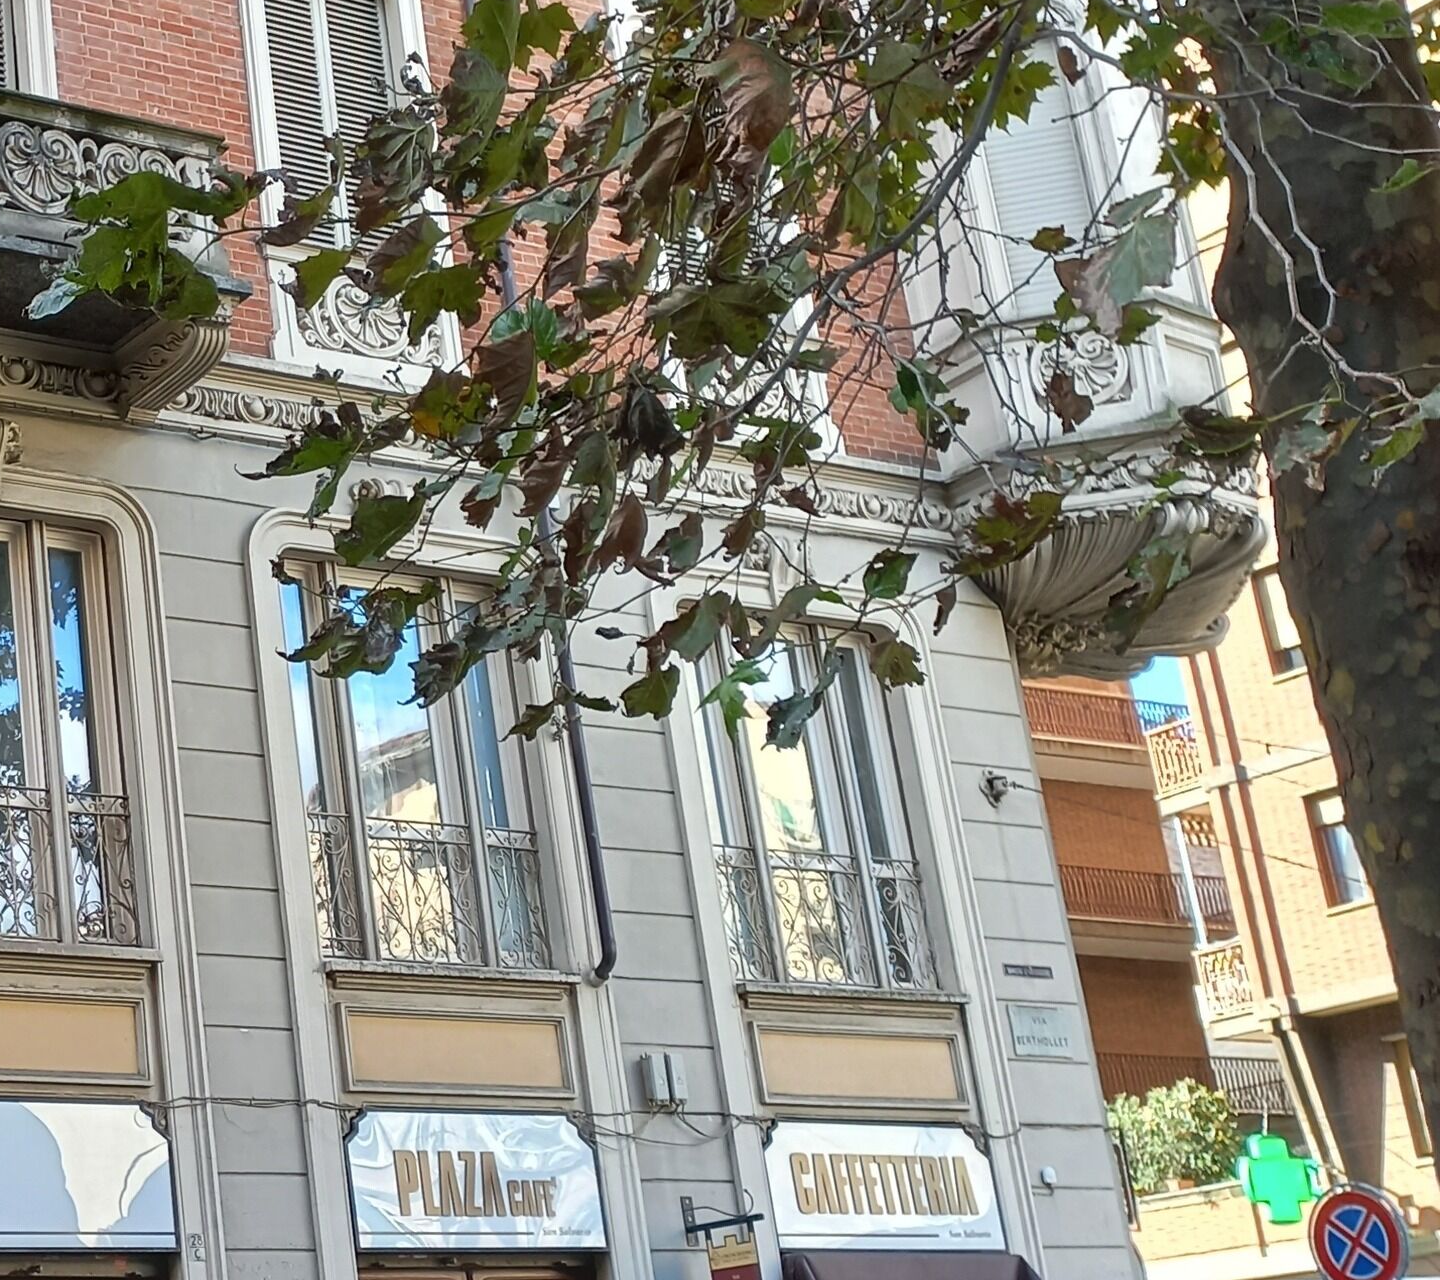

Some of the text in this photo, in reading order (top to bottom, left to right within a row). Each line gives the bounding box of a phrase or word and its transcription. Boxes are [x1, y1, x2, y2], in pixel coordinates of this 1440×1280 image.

[1031, 1016, 1048, 1025] VIA
[392, 1149, 508, 1217] PLAZA
[788, 1152, 980, 1216] CAFFETTERIA
[189, 1233, 204, 1247] 28
